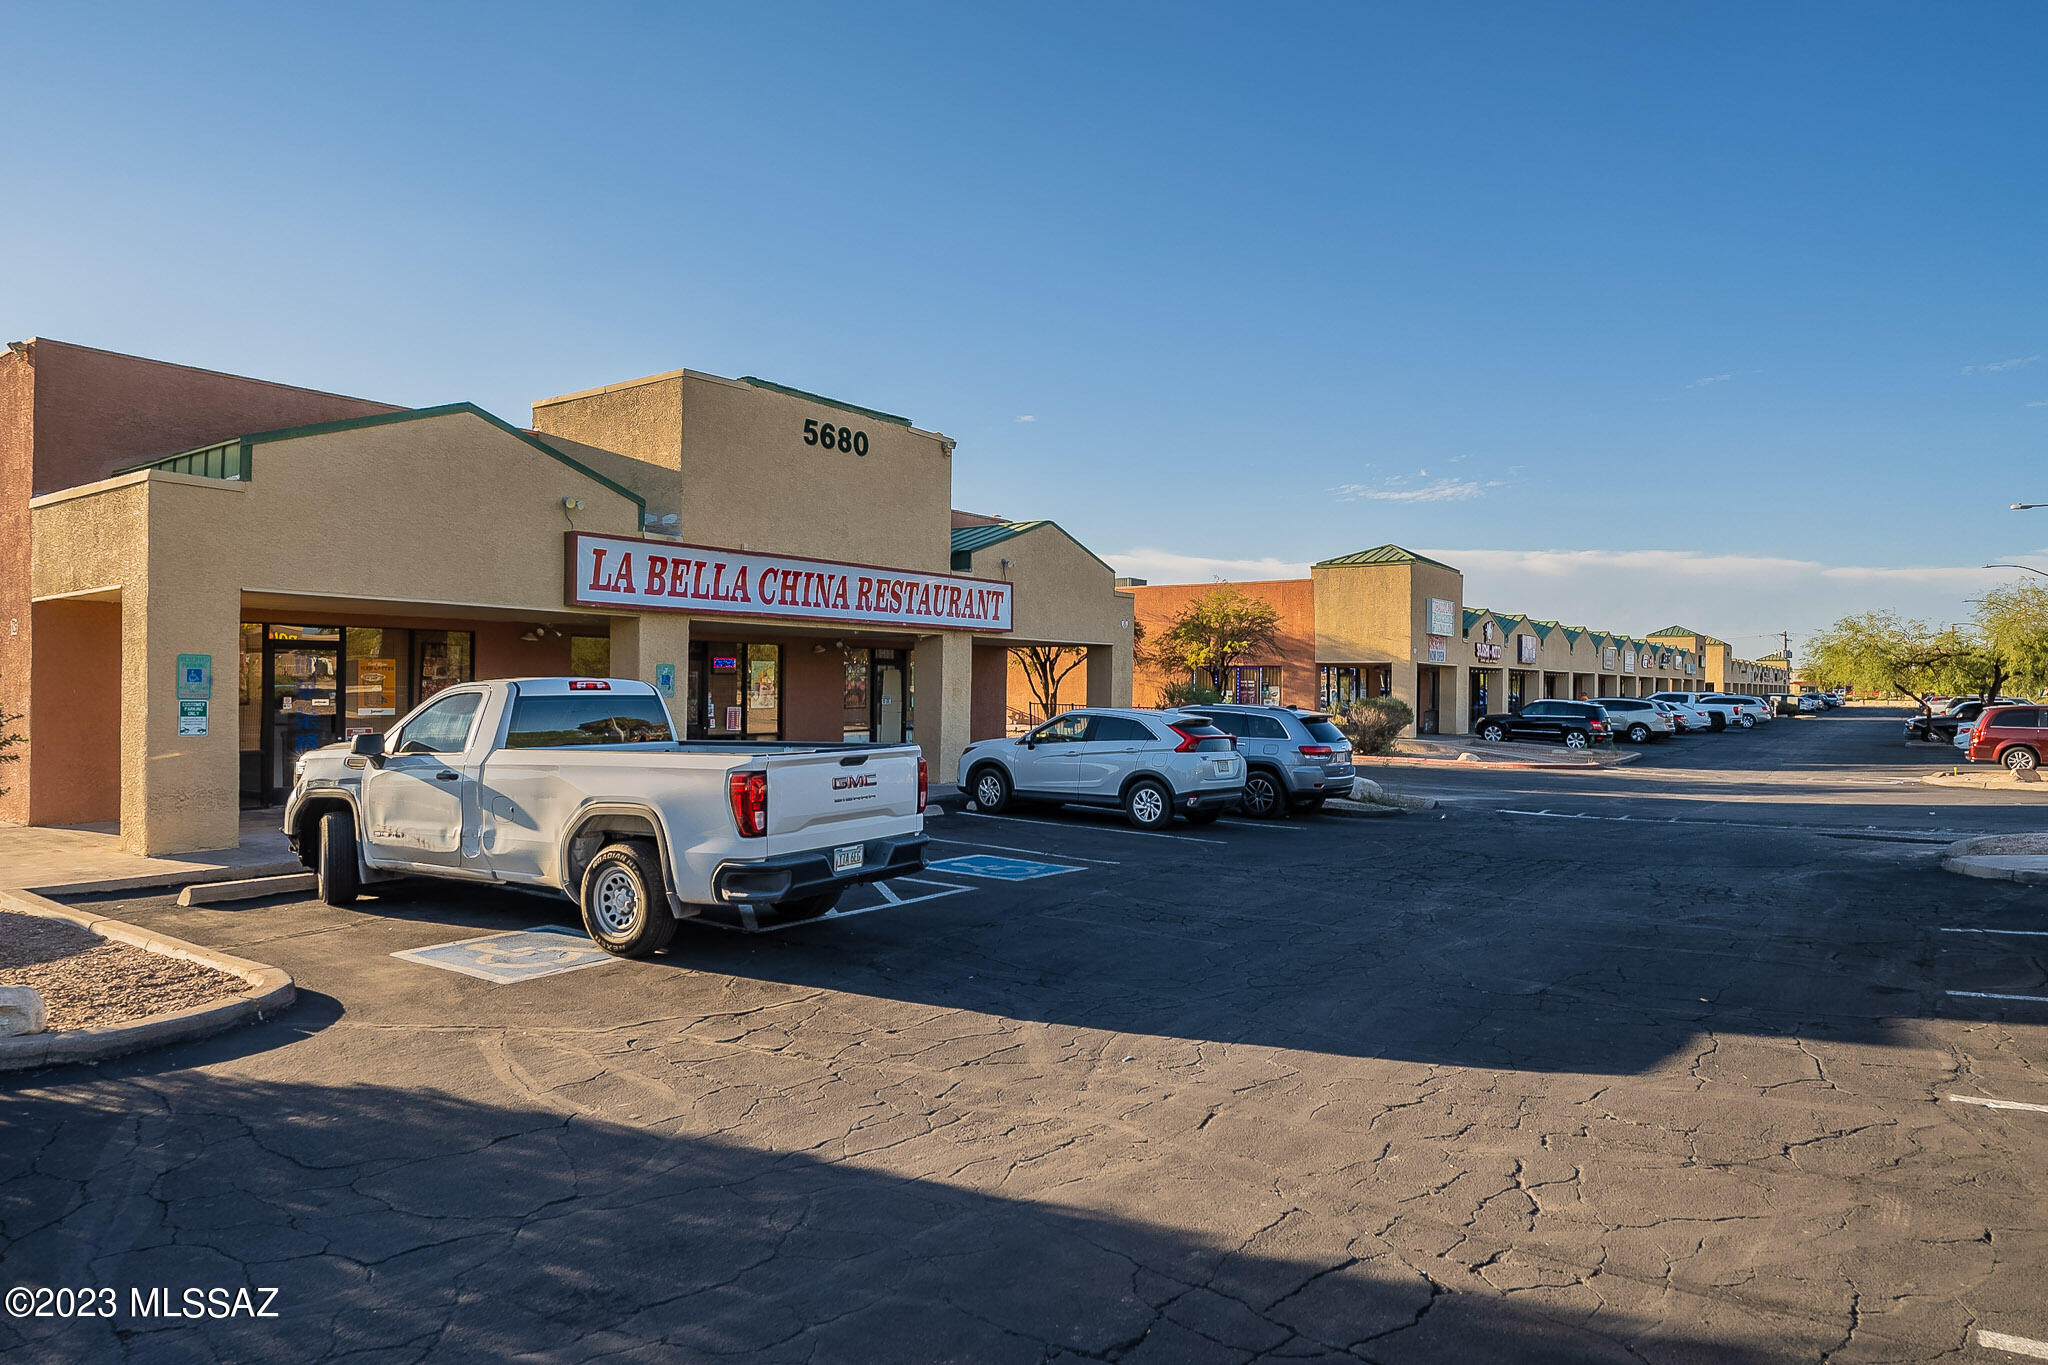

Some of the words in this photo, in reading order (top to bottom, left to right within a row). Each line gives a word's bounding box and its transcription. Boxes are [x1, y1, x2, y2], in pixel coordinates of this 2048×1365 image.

[803, 418, 869, 457] 5680
[588, 548, 637, 594] LA
[643, 555, 753, 603] BELLA
[757, 567, 851, 611] CHINA
[855, 576, 1004, 621] RESTAURANT
[832, 773, 878, 791] GMC
